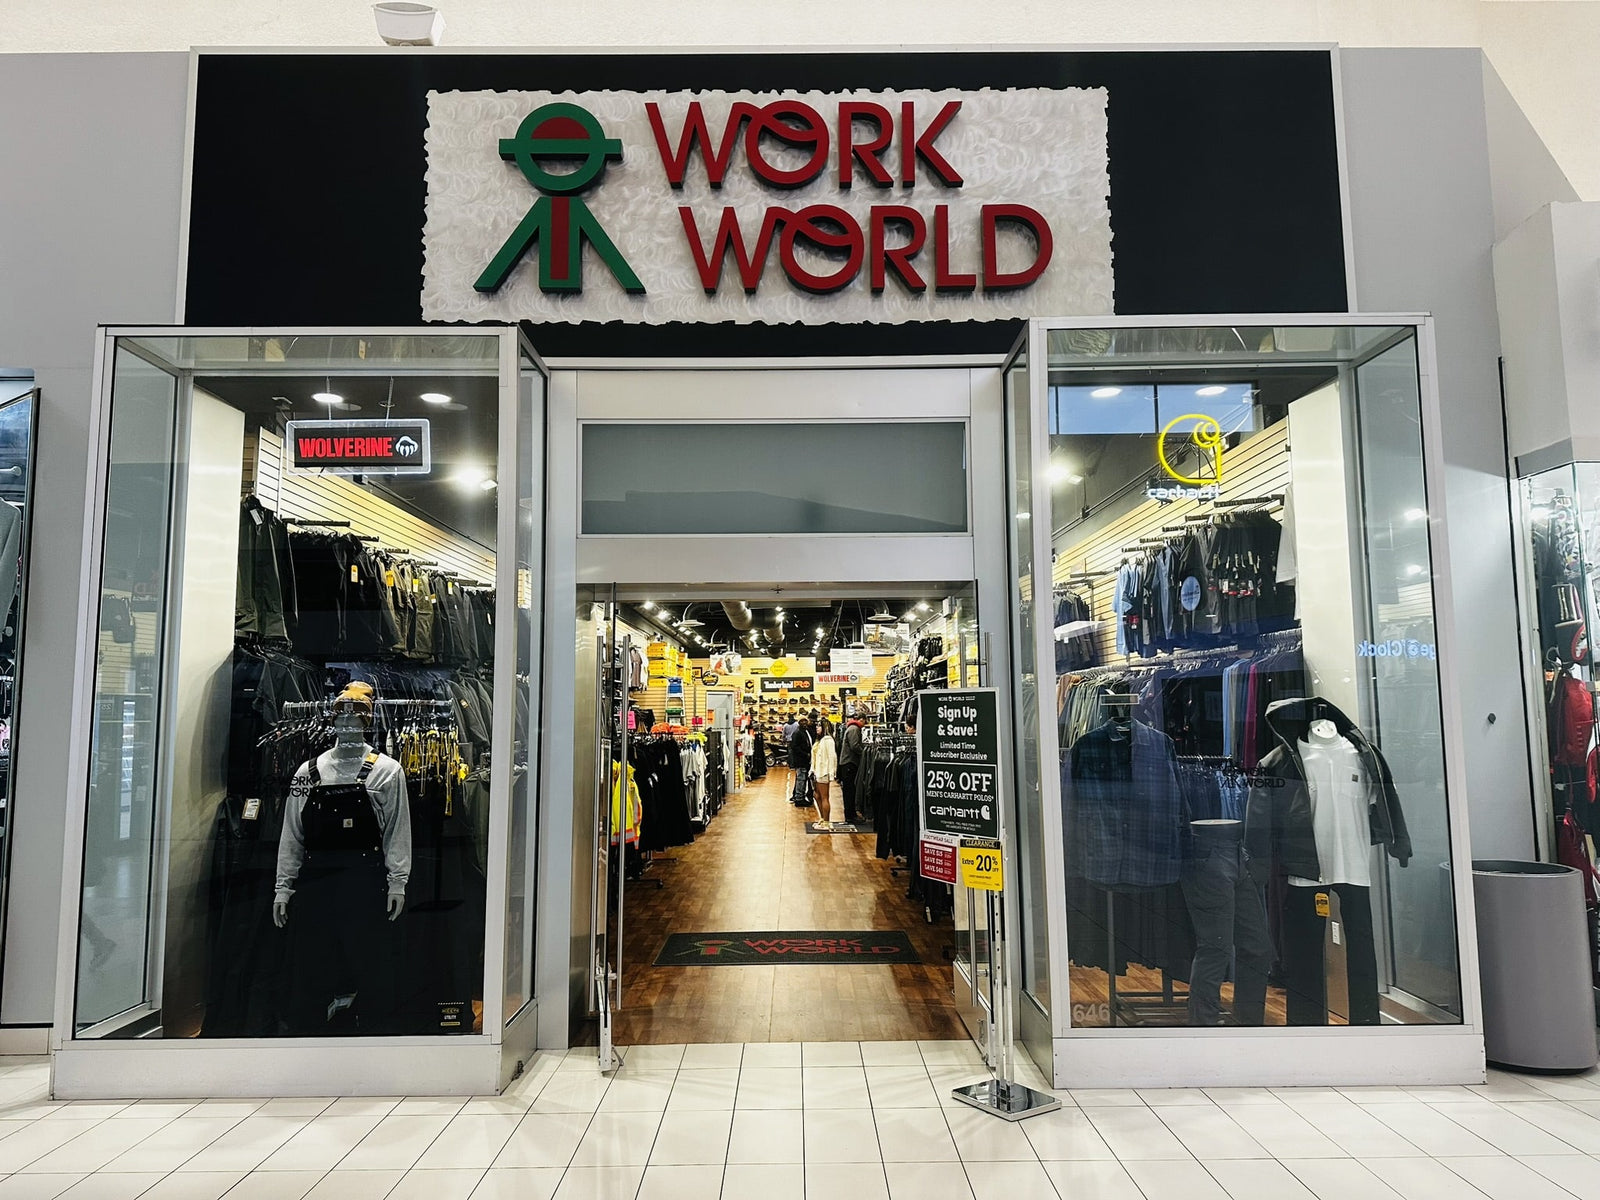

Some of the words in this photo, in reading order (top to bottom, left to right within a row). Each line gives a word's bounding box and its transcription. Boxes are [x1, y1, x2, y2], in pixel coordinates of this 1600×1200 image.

[645, 100, 963, 188] WORK
[677, 203, 1053, 294] WORLD
[298, 436, 393, 458] WOLVERINE
[793, 680, 811, 688] PRO
[937, 705, 961, 722] Sign
[962, 706, 977, 722] Up
[937, 724, 946, 736] &
[946, 723, 978, 736] Save!
[940, 741, 960, 749] Limited
[961, 742, 976, 750] Time
[930, 750, 959, 759] Subscriber
[960, 751, 988, 760] Exclusive
[927, 770, 956, 789] 25%
[959, 772, 992, 792] OFF
[926, 790, 943, 798] MEN'S
[943, 791, 973, 801] CARHARTT
[929, 805, 980, 819] carhartt
[965, 839, 995, 848] CLEARANCE
[752, 946, 900, 954] WORLD
[1073, 1003, 1110, 1023] 646
